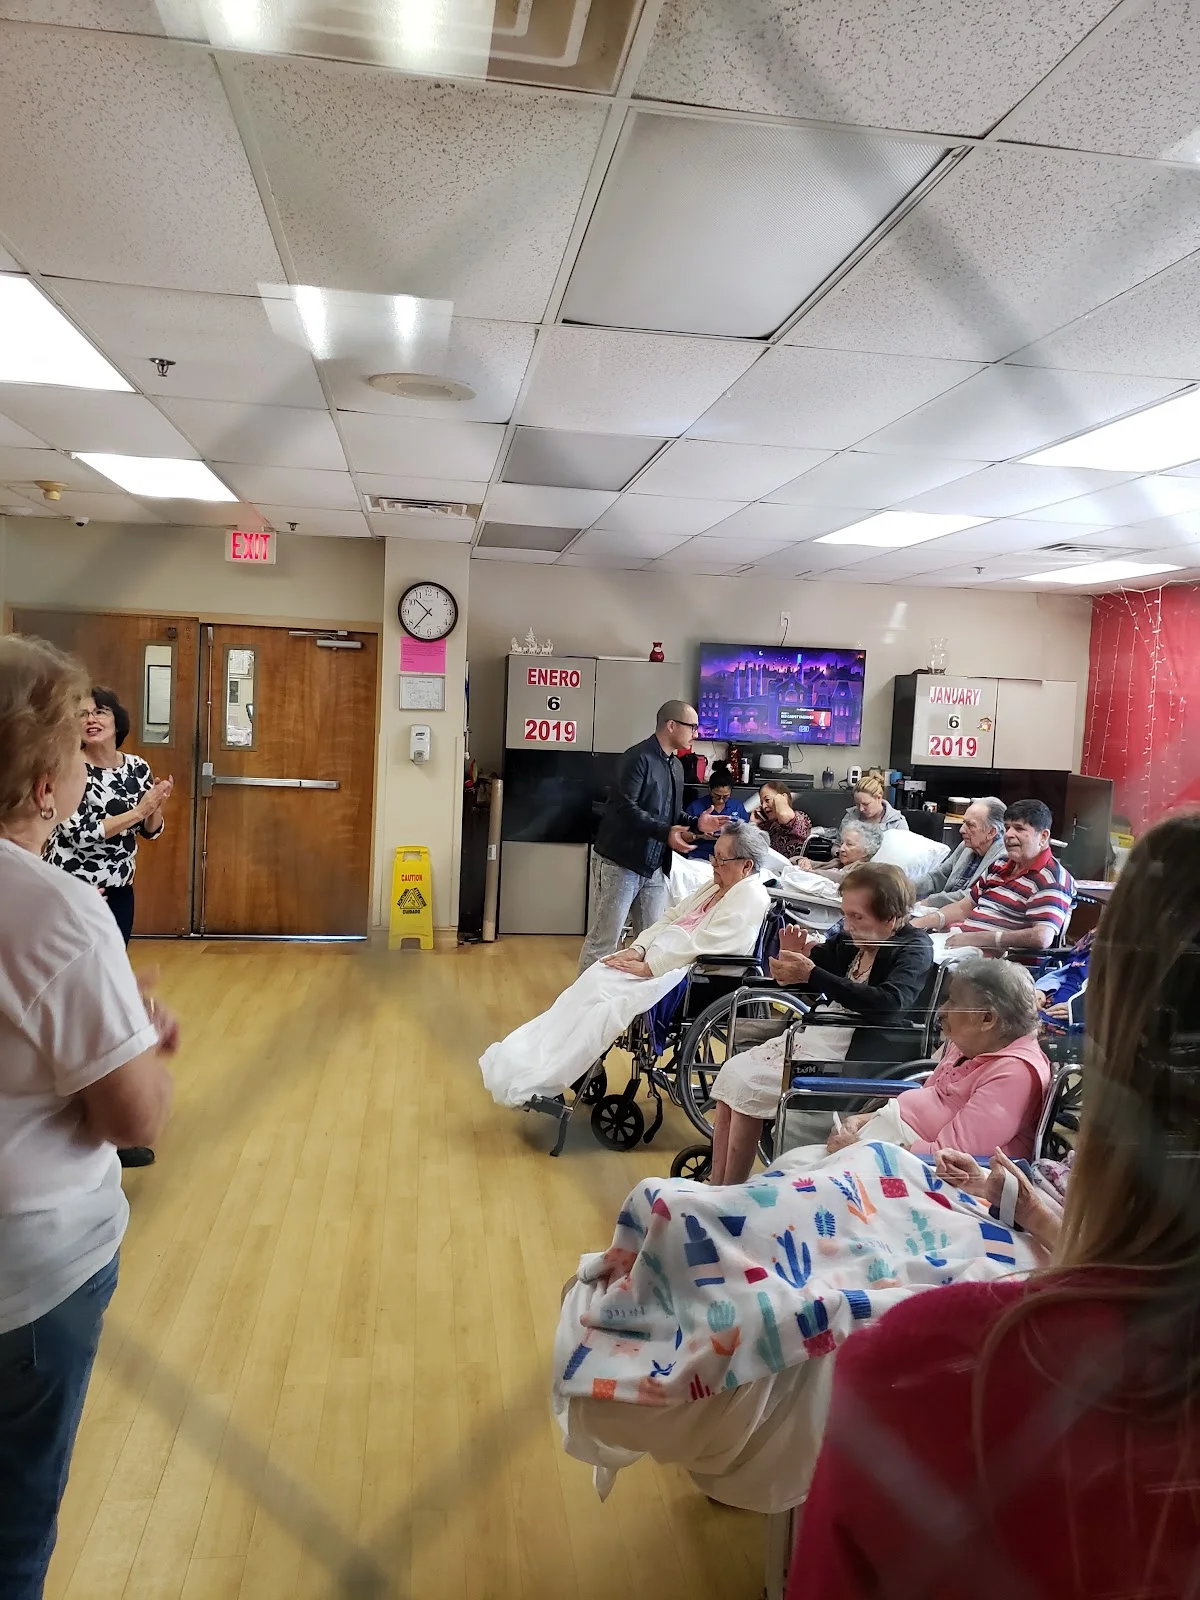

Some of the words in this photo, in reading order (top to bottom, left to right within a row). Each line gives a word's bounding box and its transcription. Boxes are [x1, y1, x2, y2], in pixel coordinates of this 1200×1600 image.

[232, 532, 271, 560] EXIT
[527, 668, 580, 688] ENERO
[547, 696, 560, 711] 6
[930, 686, 980, 706] JANUARY
[524, 719, 576, 742] 2019
[948, 715, 960, 729] 6
[929, 736, 978, 757] 2019
[401, 874, 423, 882] CAUTION
